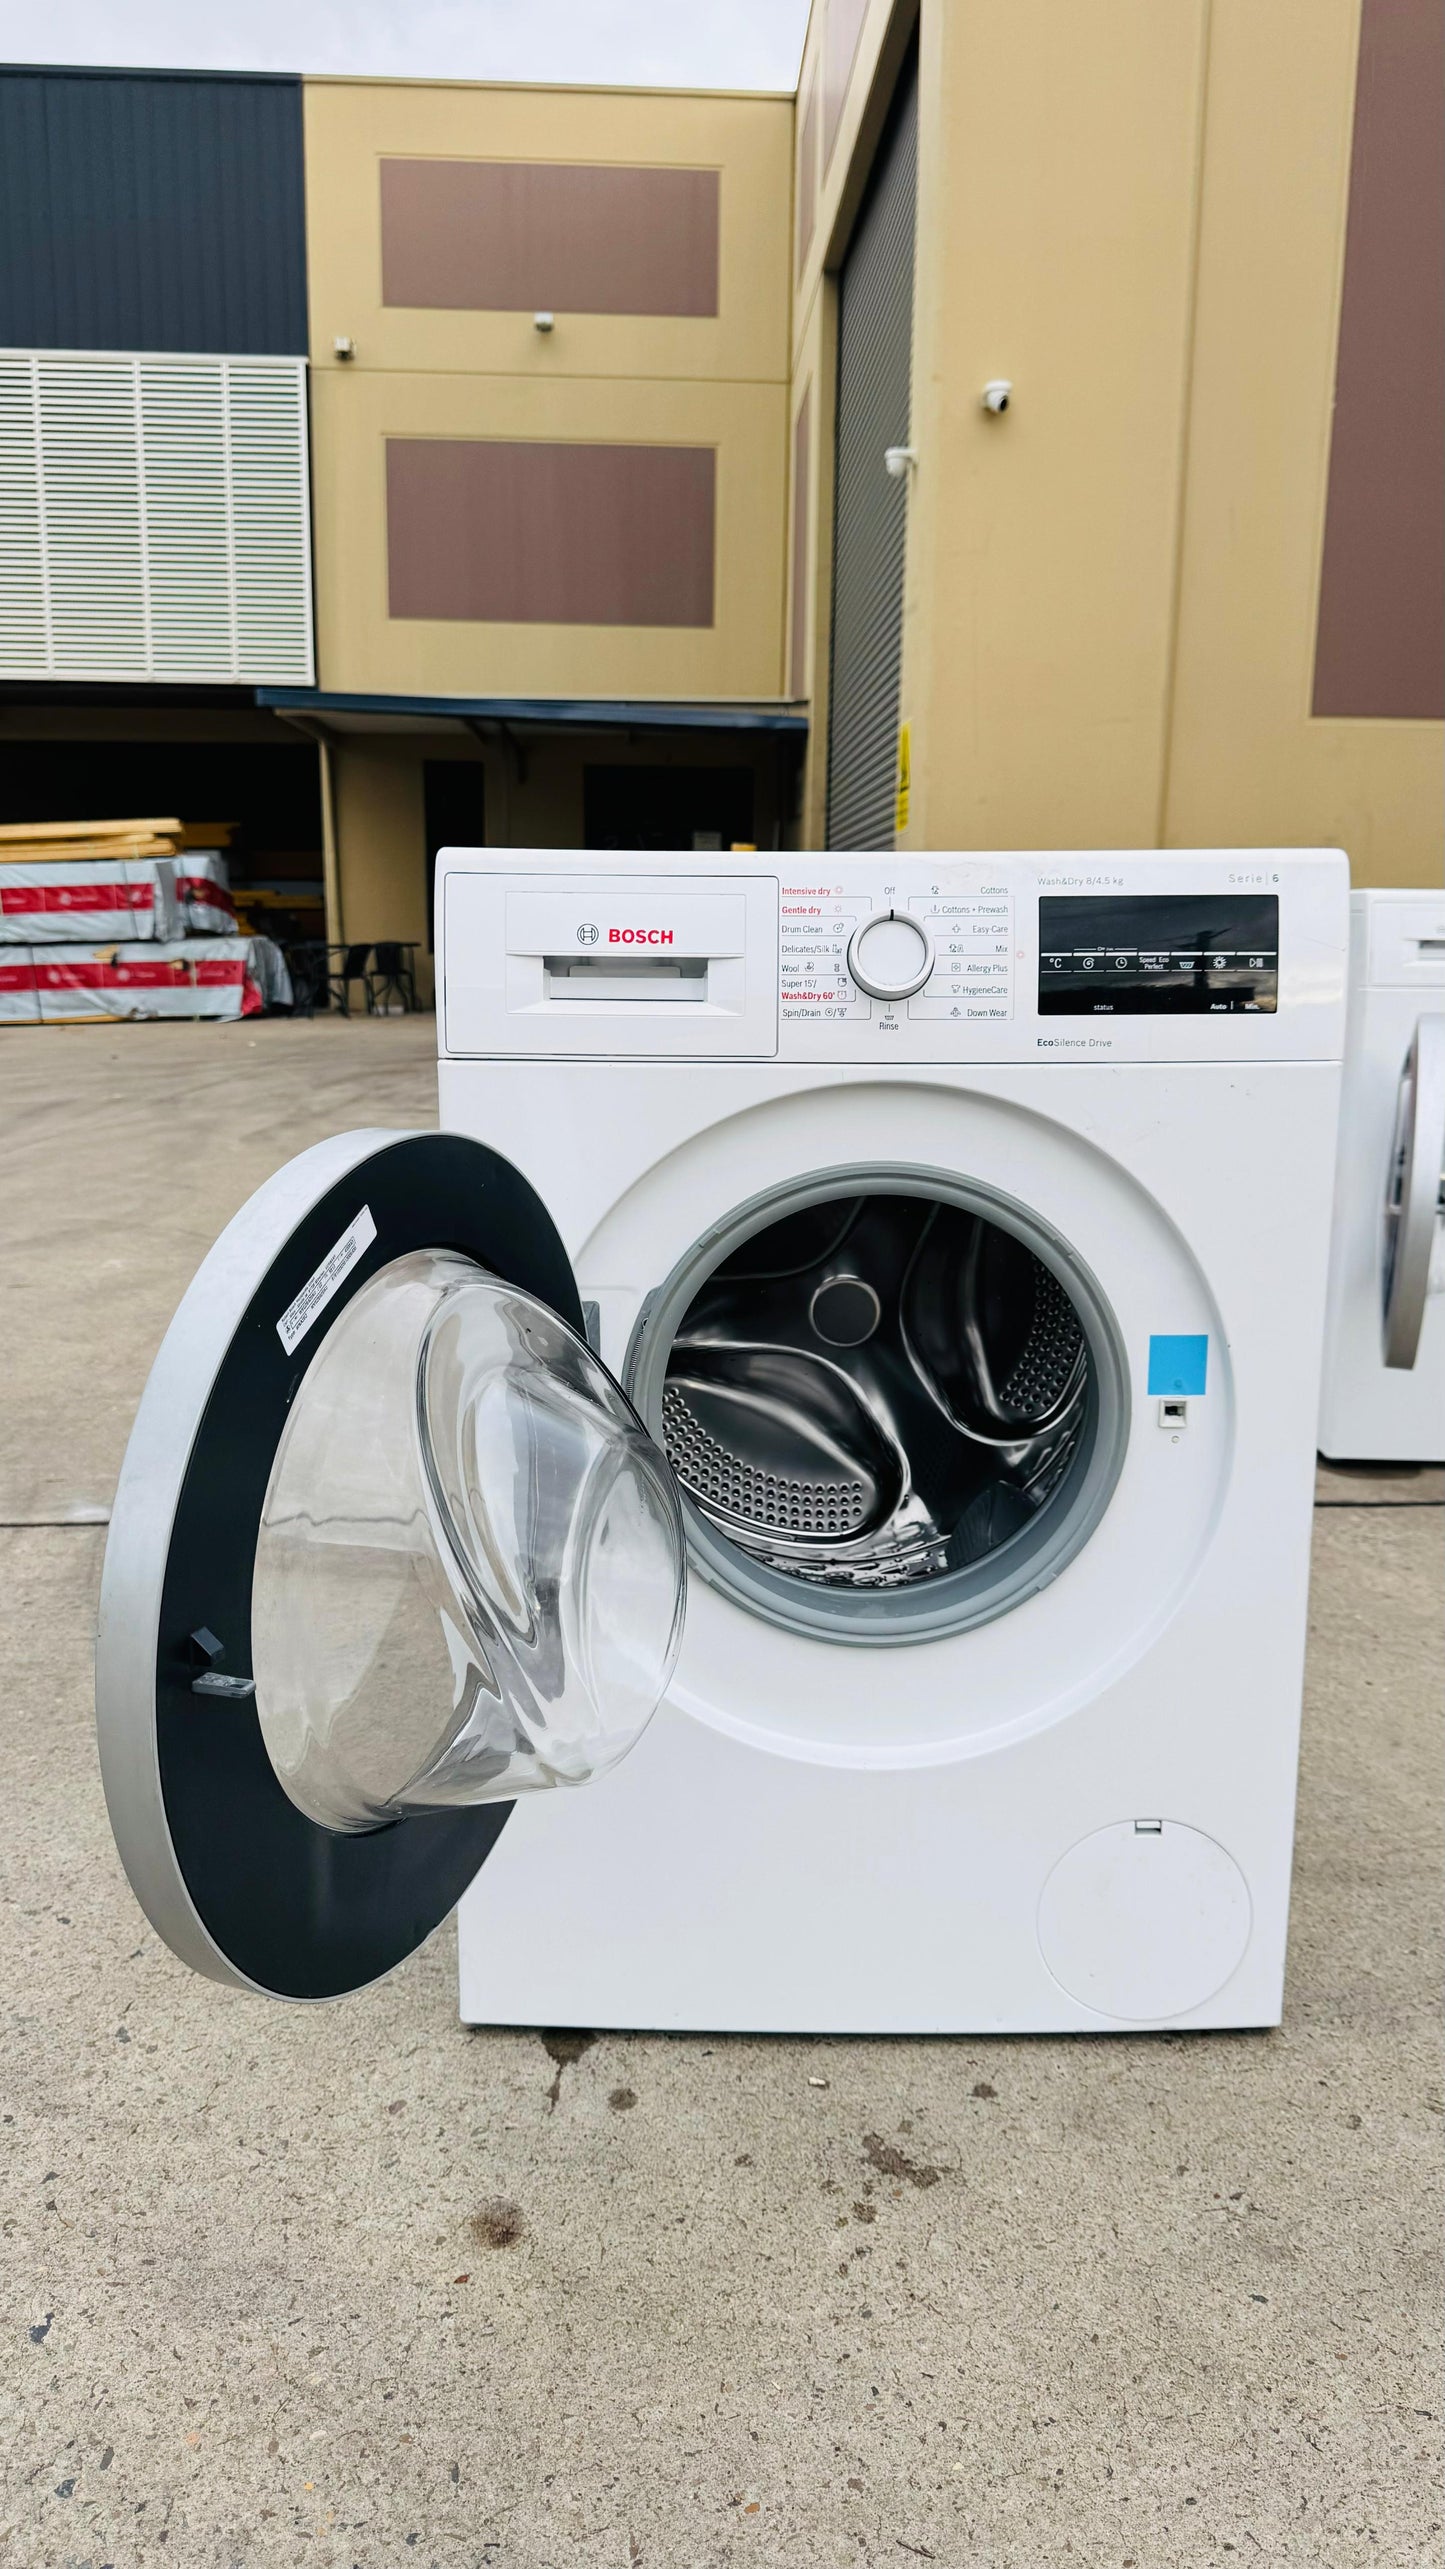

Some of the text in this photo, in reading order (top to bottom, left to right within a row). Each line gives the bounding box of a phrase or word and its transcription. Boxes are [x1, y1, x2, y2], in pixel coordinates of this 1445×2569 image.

[1037, 877, 1124, 887] Wash&Dry 8/4.5 kg
[1228, 874, 1279, 884] Serie 6
[782, 887, 831, 896] Intensive dry
[884, 886, 895, 895] Off
[980, 887, 1008, 895] Cottons
[782, 906, 821, 915] Gentle dry
[978, 905, 1008, 913] Prewash
[782, 925, 823, 933] Drum Clean
[608, 928, 674, 944] BOSCH
[782, 945, 829, 954] Delicates/Silk
[782, 964, 799, 972] Wool
[967, 964, 1008, 974] Allergy Plus
[1144, 962, 1164, 970] Perfect
[782, 980, 802, 989] Super
[963, 985, 1008, 995] HygieneCare
[782, 992, 822, 1001] Wash&Dry
[782, 1009, 821, 1018] Spin/Drain
[879, 1022, 899, 1031] Rinse
[1037, 1038, 1112, 1047] EcoSilence Drive
